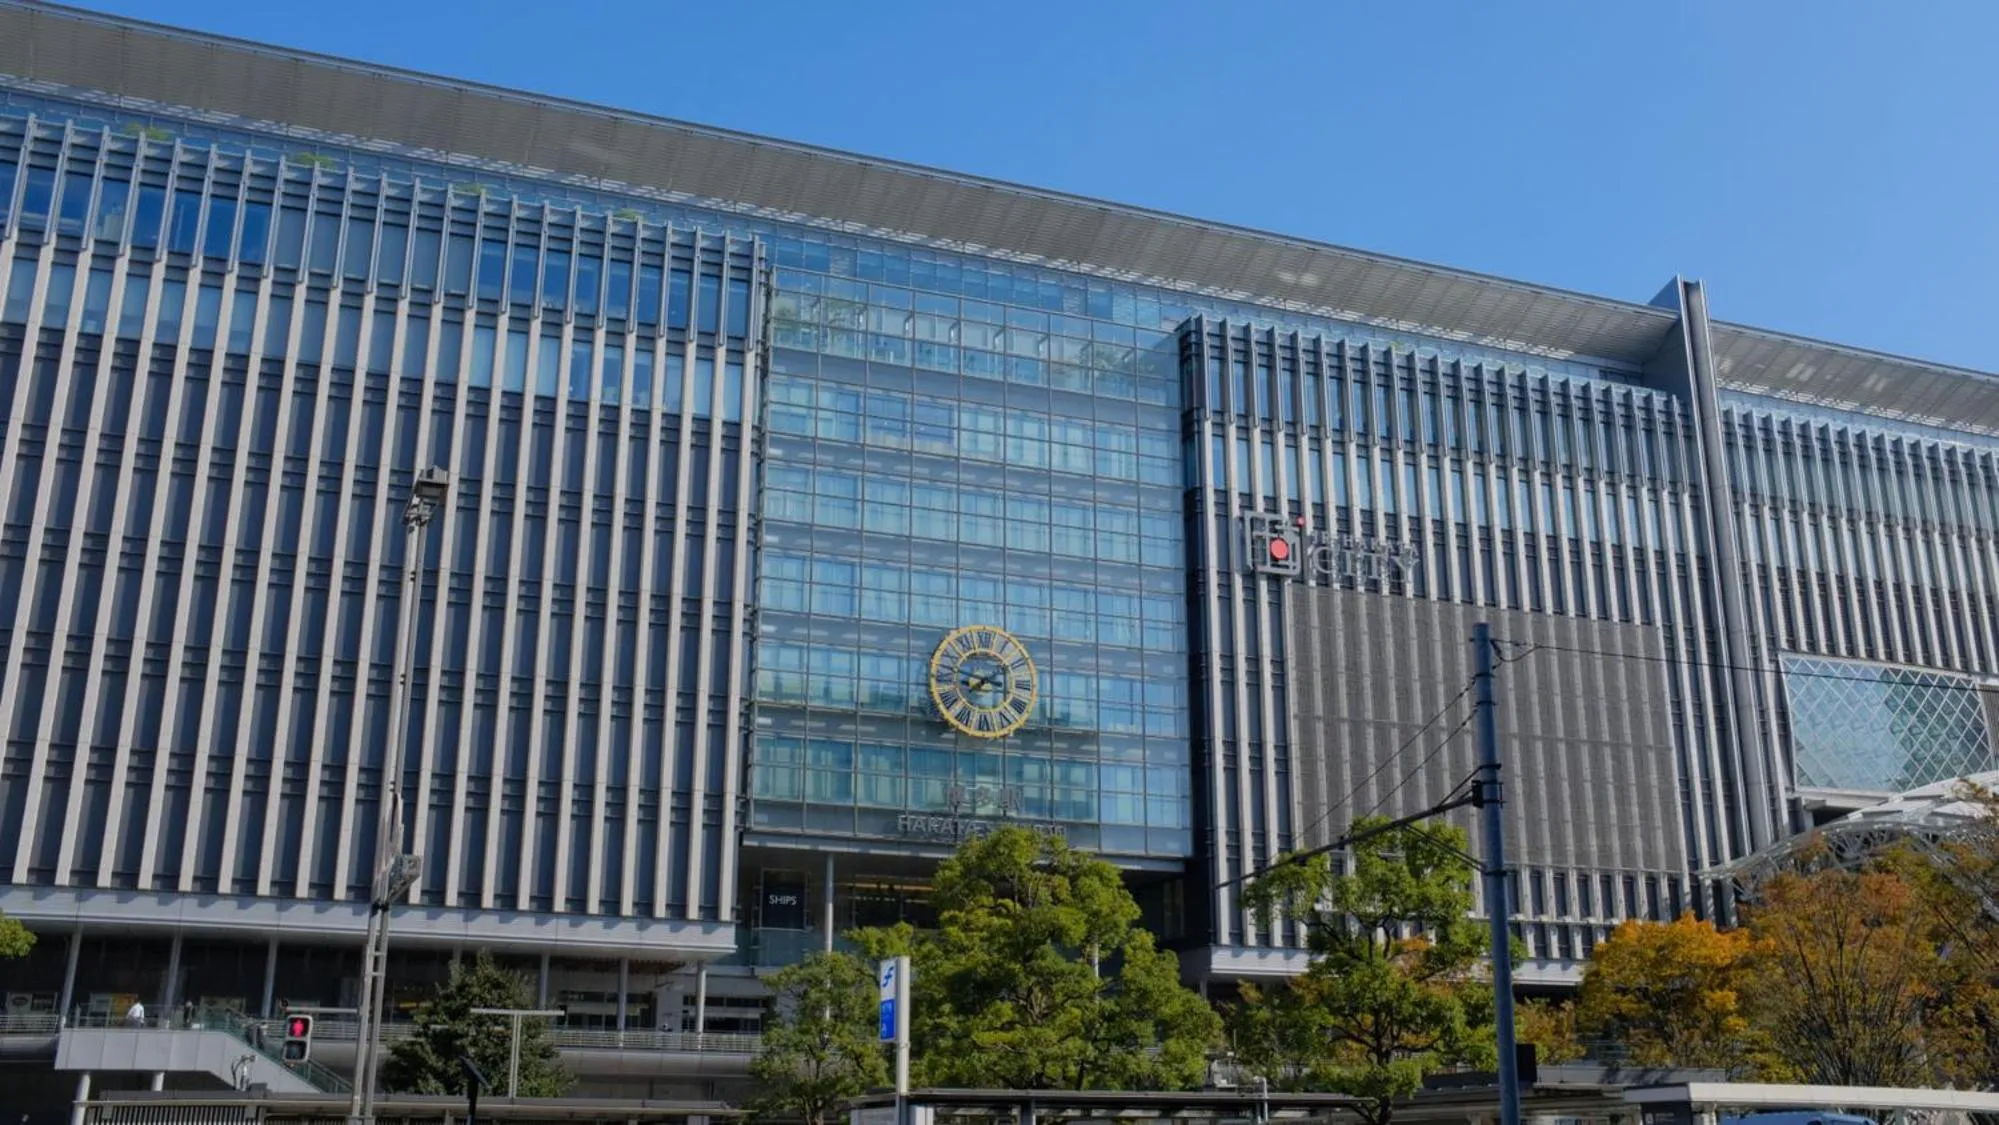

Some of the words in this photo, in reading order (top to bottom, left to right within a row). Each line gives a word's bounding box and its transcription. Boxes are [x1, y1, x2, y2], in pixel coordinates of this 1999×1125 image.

[1312, 531, 1329, 545] JR
[1313, 546, 1420, 582] CITY
[769, 894, 797, 906] SHIPS
